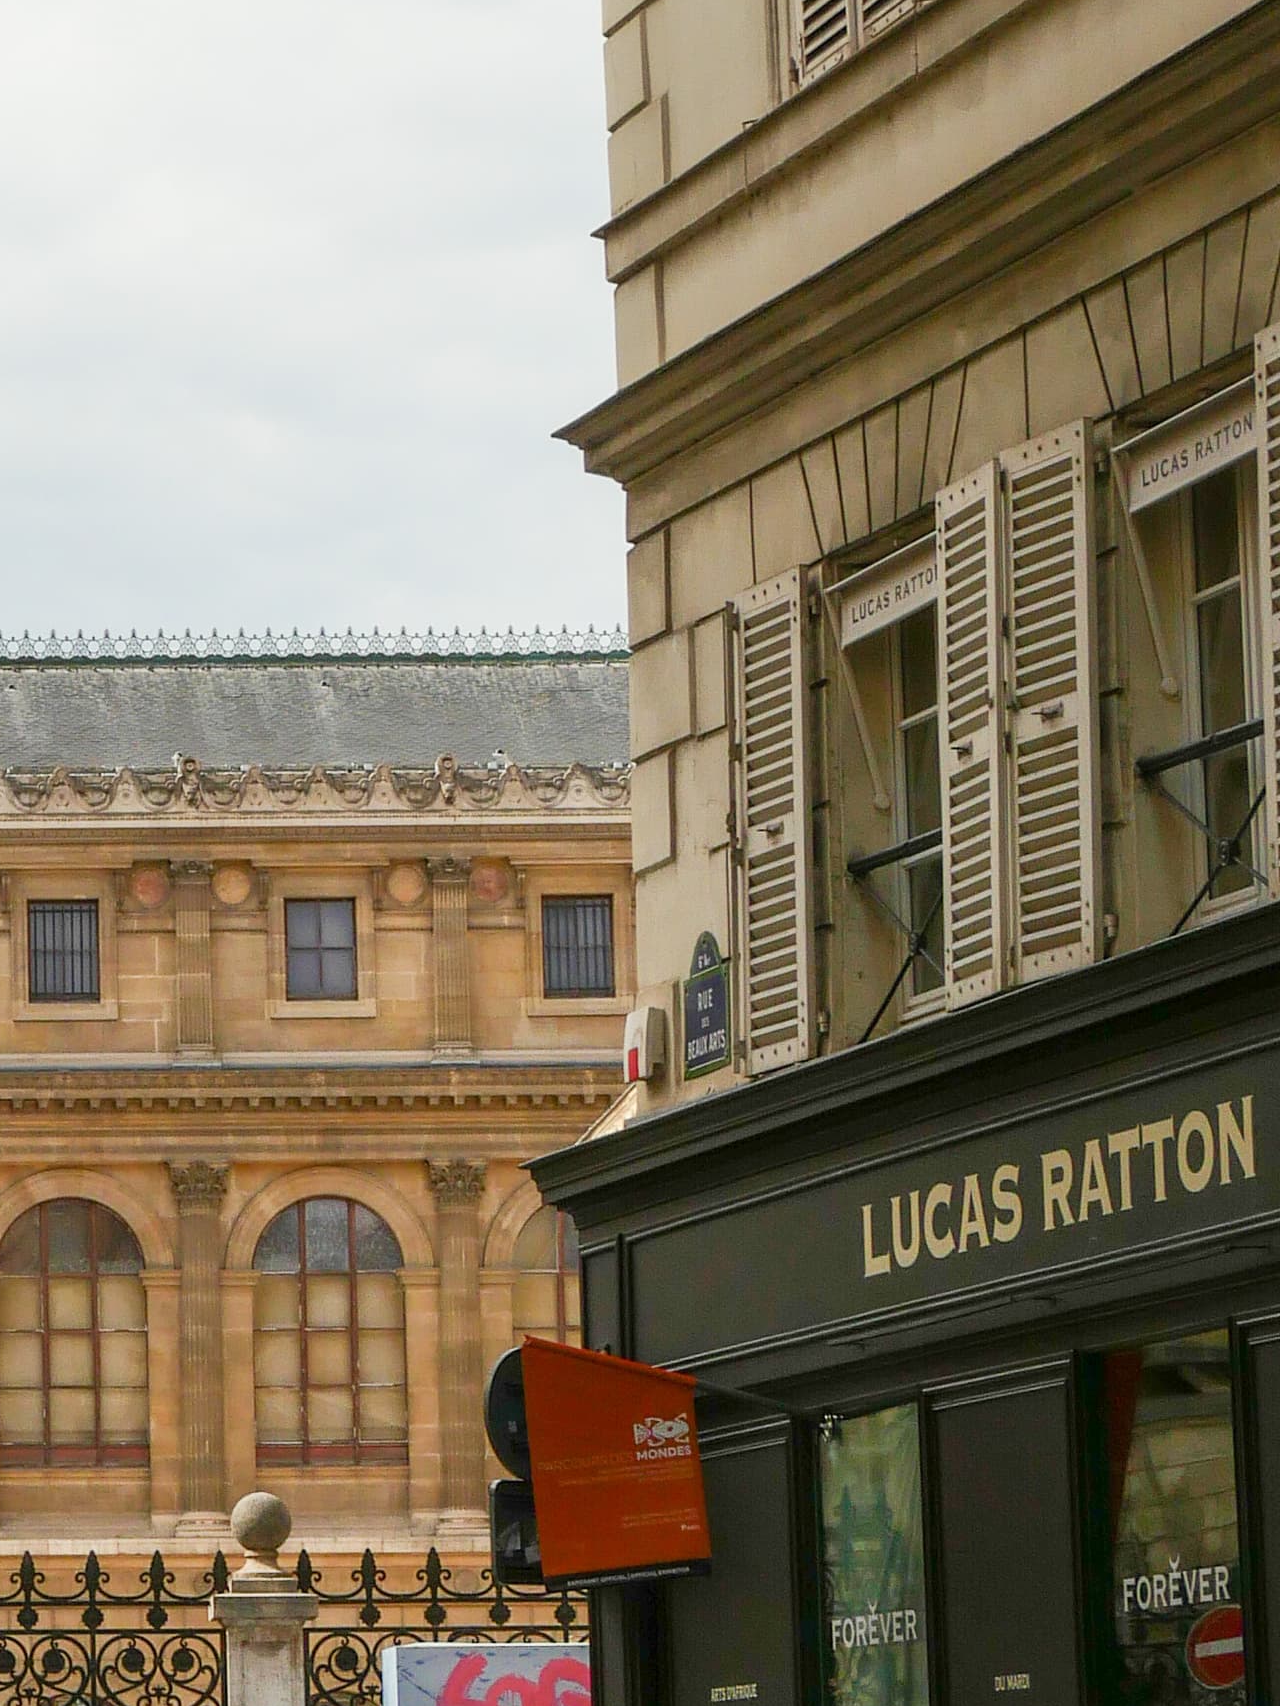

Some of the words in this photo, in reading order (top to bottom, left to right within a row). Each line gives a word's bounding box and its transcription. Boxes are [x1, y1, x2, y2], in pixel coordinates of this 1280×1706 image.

[1142, 450, 1189, 488] LUCAS
[1195, 413, 1253, 462] RATTON
[851, 591, 890, 624] LUCAS
[697, 988, 713, 1012] RUE
[701, 1016, 710, 1029] DES
[688, 1034, 708, 1061] BEAUX
[708, 1028, 725, 1053] ARTS
[861, 1163, 1023, 1278] LUCAS
[1041, 1093, 1257, 1233] RATTON
[636, 1444, 692, 1461] MONDES
[994, 1676, 1005, 1692] DU
[1006, 1673, 1030, 1691] MARDI
